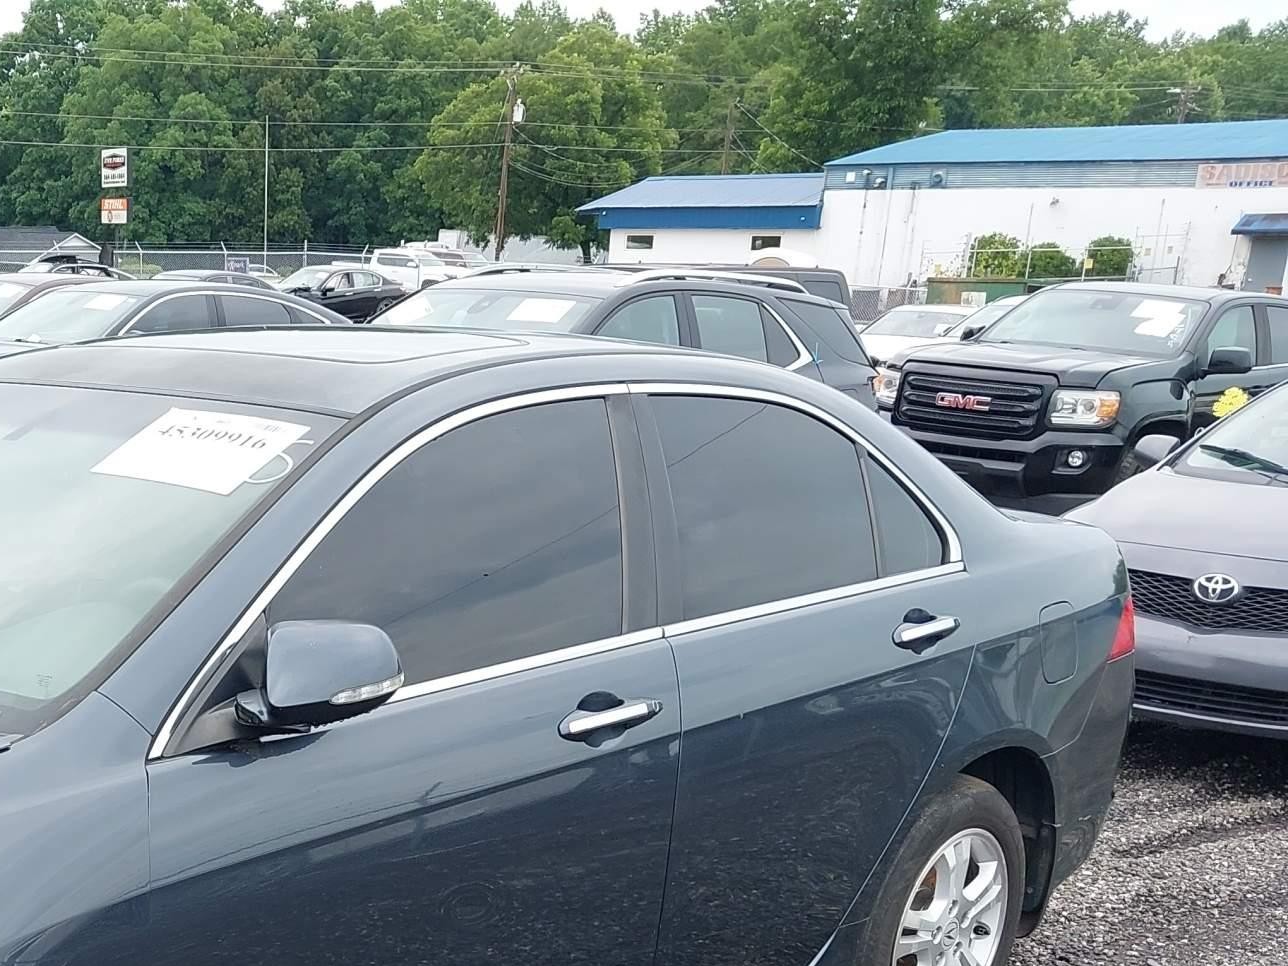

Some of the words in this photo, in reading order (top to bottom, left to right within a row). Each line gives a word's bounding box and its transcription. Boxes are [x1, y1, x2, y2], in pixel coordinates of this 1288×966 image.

[104, 200, 124, 210] STIHL
[936, 392, 992, 411] GMC
[158, 424, 267, 449] 45309916
